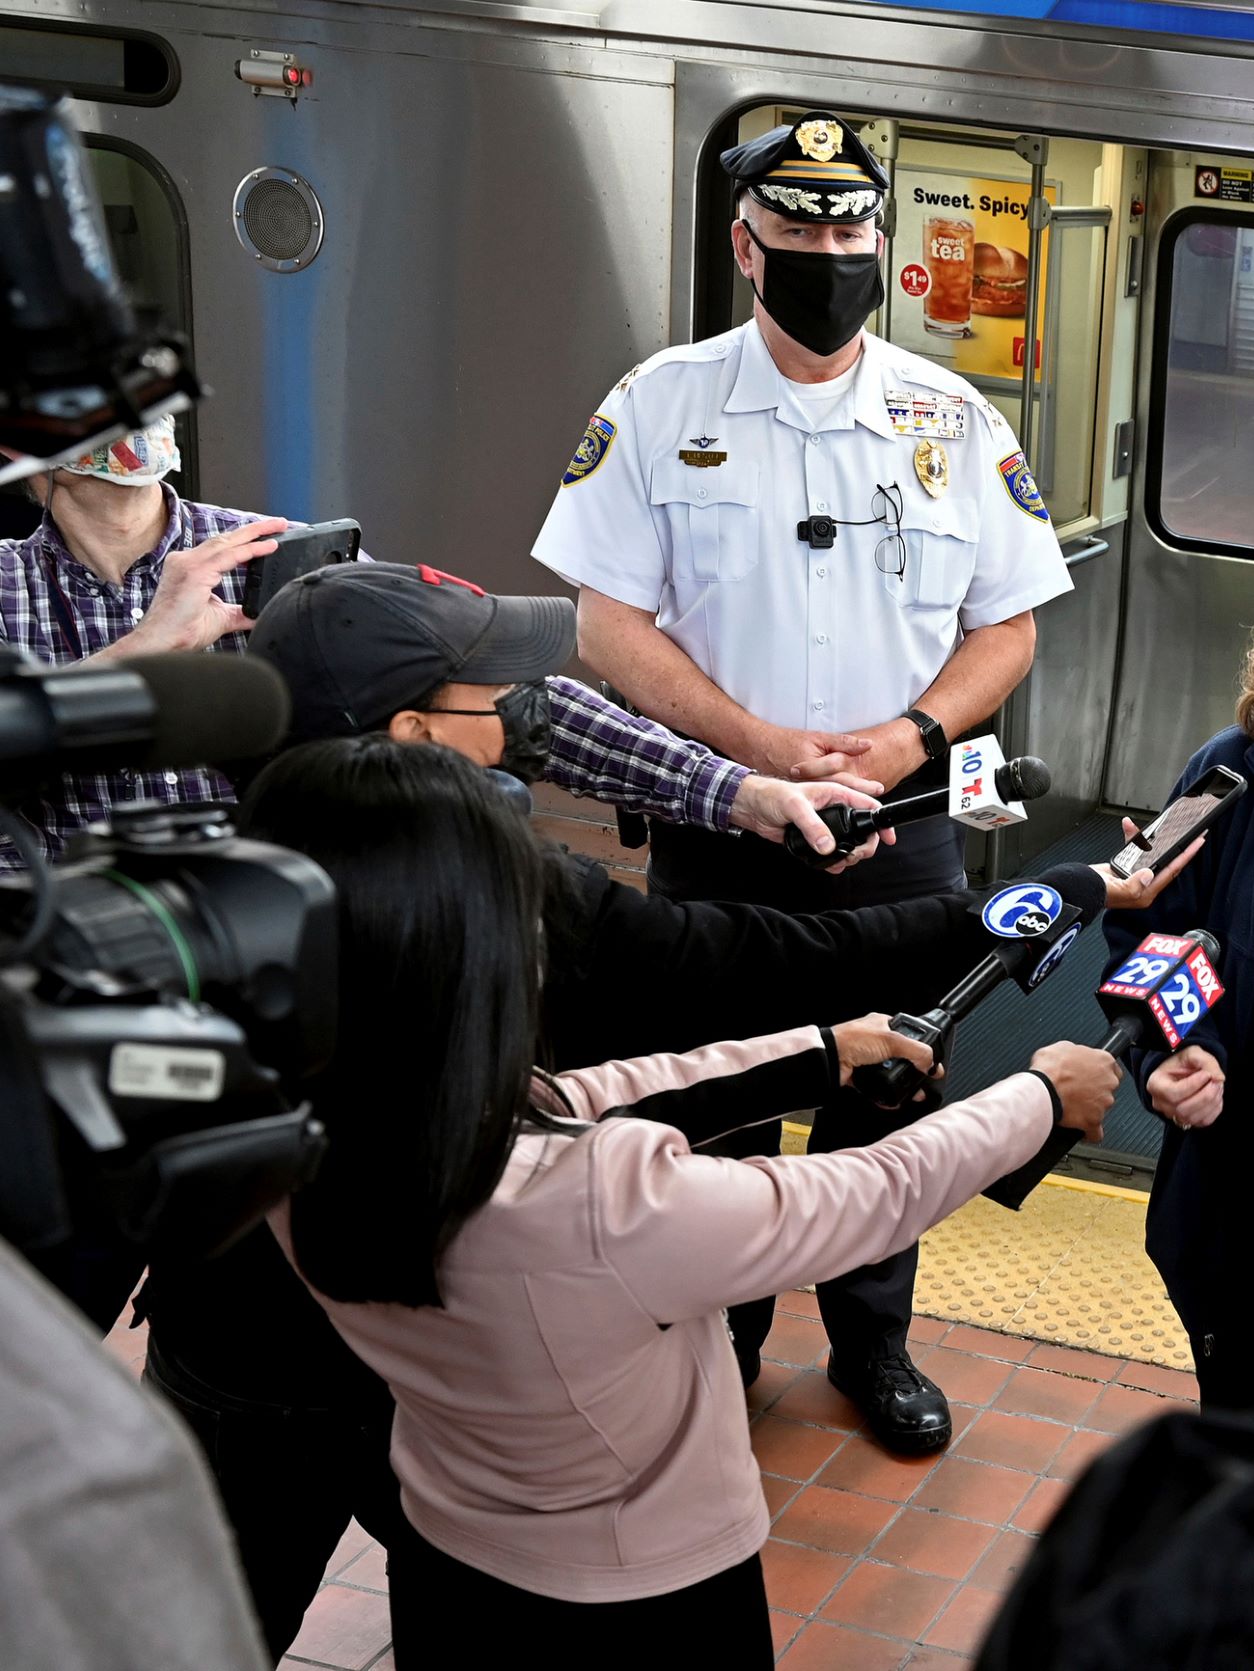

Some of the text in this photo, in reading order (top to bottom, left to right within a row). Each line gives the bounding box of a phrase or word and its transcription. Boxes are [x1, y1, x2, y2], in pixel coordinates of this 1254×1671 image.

[913, 188, 1028, 220] Sweet. Spicy
[931, 239, 965, 262] tea
[938, 236, 965, 247] sweet
[961, 751, 982, 774] 10
[961, 796, 971, 810] 62
[1017, 915, 1047, 932] abc
[1143, 937, 1187, 955] FOX
[1112, 957, 1169, 985] 29
[1103, 984, 1146, 995] NEWS
[1189, 953, 1220, 1021] FOX
[1159, 973, 1200, 1025] 29
[1150, 998, 1178, 1044] NEWS
